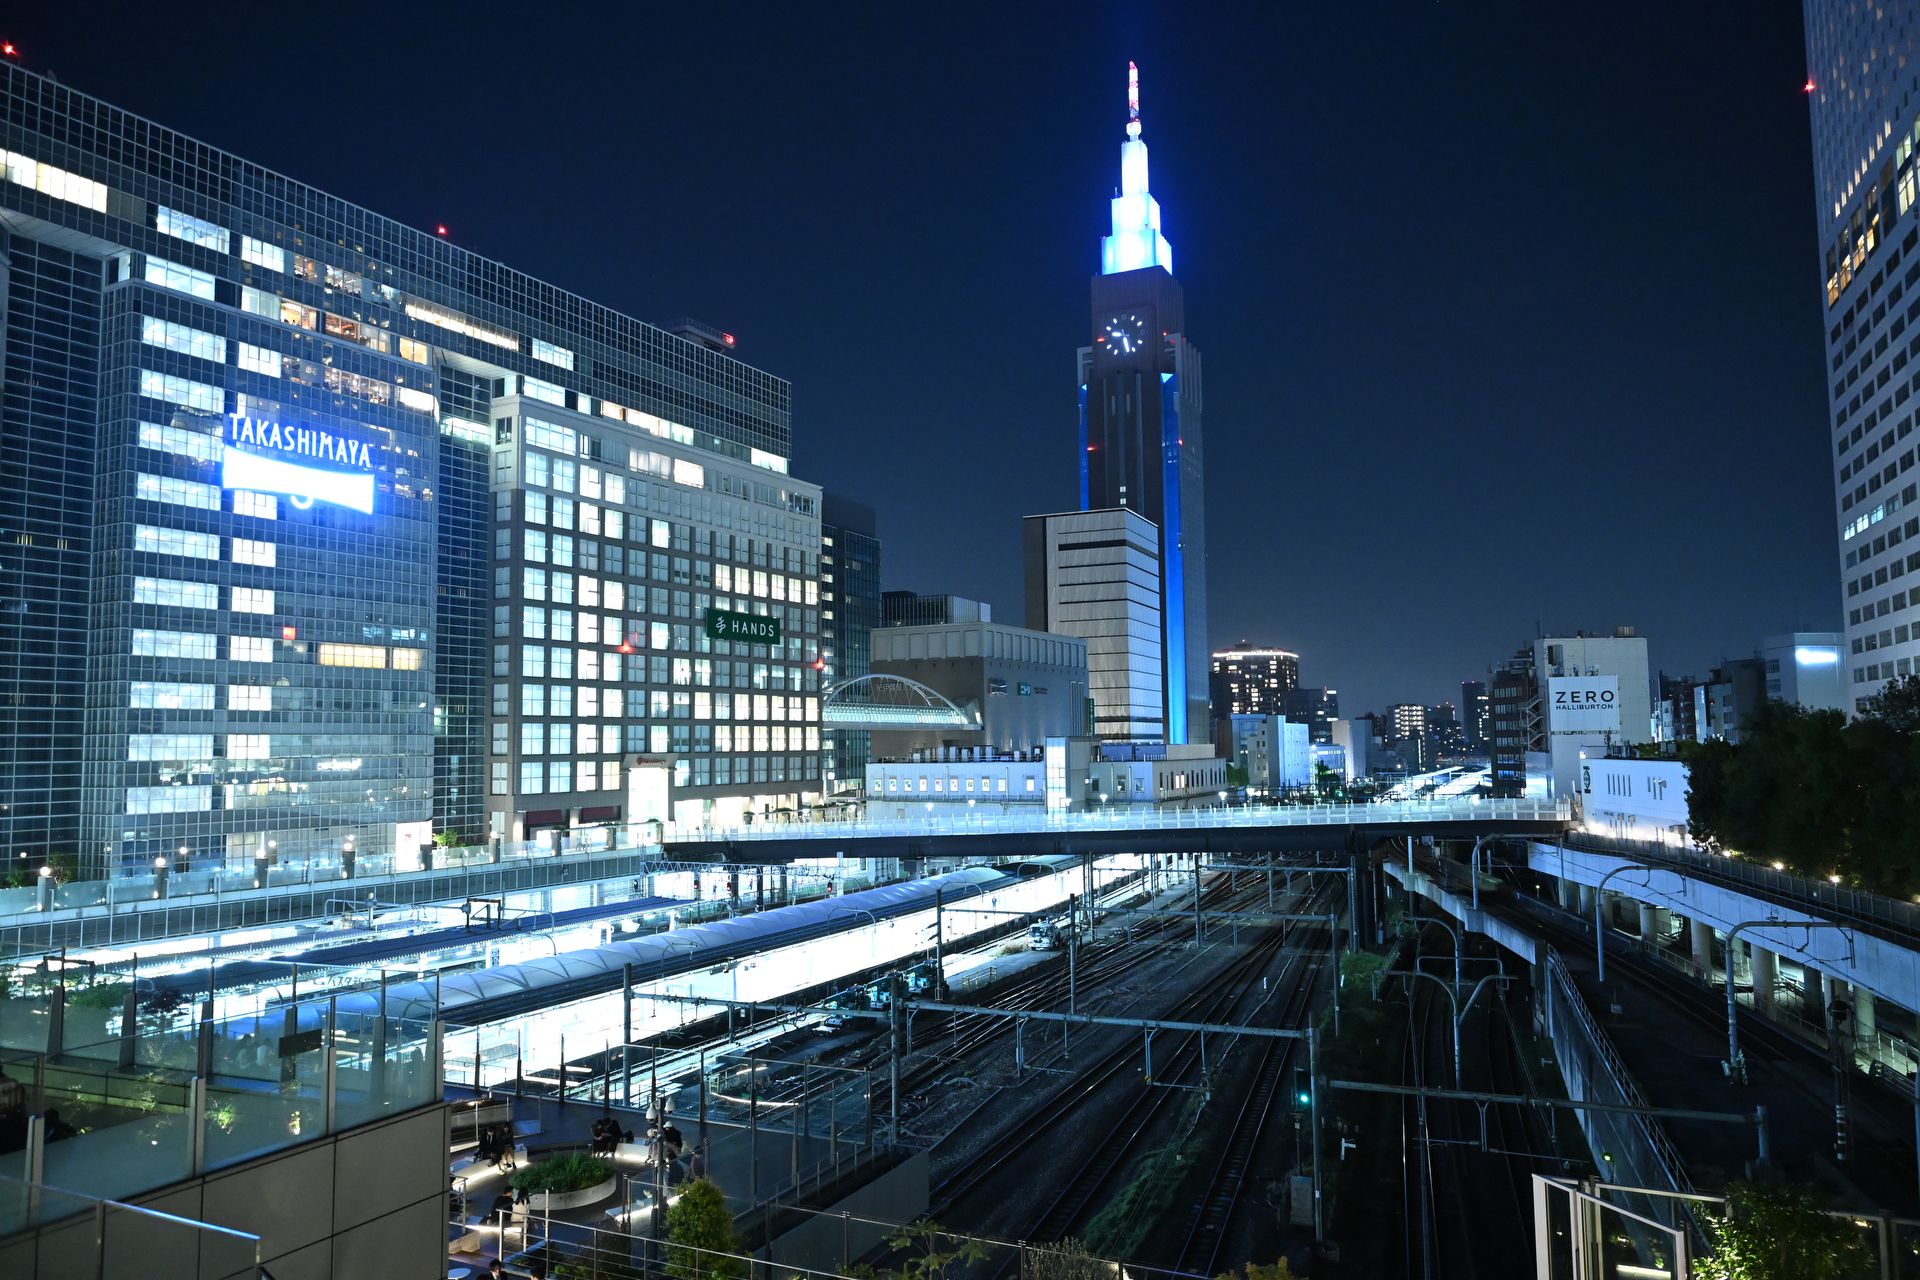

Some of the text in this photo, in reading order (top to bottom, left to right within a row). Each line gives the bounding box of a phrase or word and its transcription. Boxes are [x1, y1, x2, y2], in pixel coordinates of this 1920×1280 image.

[229, 412, 371, 468] TAKASHIMAYA
[732, 620, 774, 637] HANDS
[1555, 690, 1614, 703] ZERO
